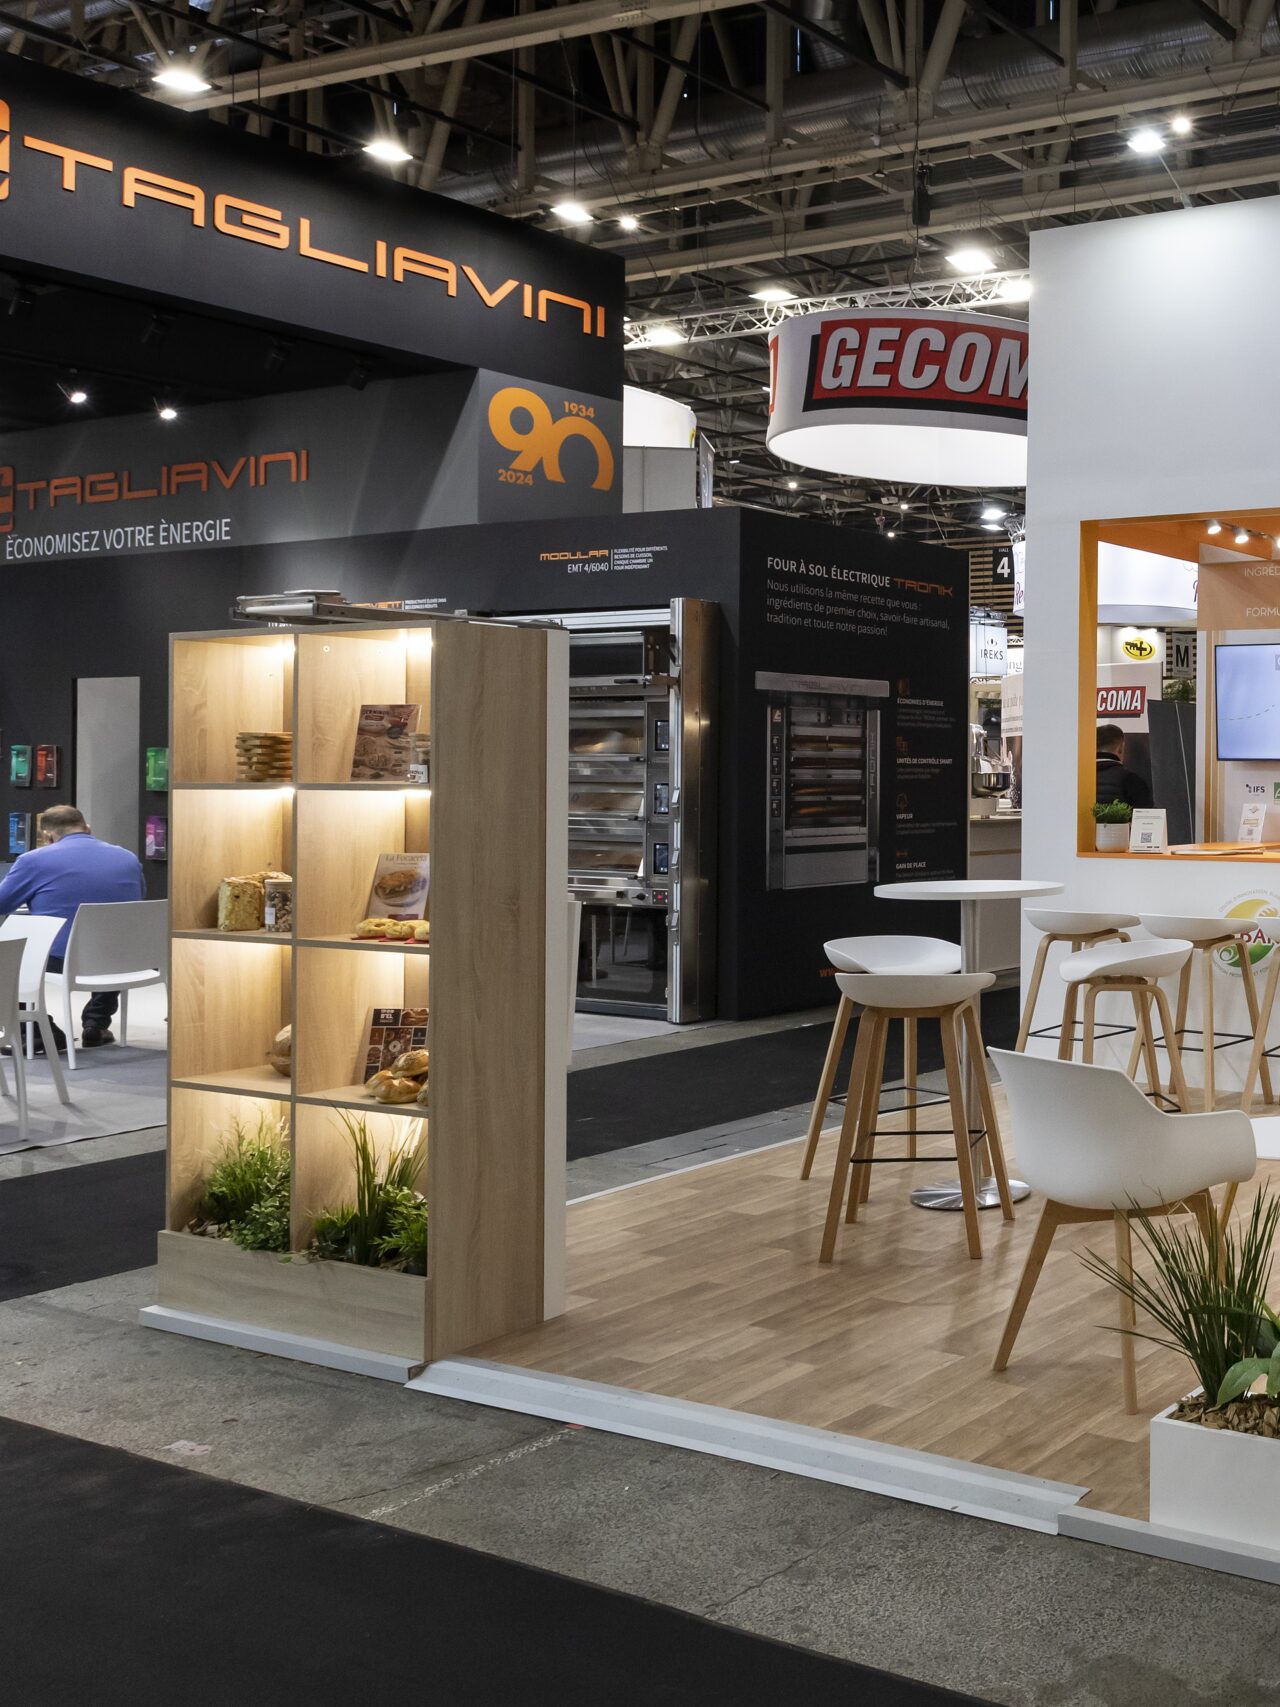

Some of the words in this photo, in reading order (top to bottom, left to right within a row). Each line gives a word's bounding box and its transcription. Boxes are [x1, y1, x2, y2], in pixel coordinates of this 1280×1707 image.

[24, 135, 605, 338] TAGLIAVINI
[820, 326, 1028, 399] GECOM
[563, 401, 595, 418] 1934
[16, 449, 309, 512] TAGLIAVINI
[498, 468, 534, 486] 2024
[103, 525, 155, 550] VOTRE
[540, 549, 609, 561] MODULAR
[996, 556, 1011, 578] 4
[567, 563, 583, 574] EMT
[583, 562, 609, 574] 4/6040
[767, 556, 796, 573] FOUR
[799, 558, 807, 574] À
[808, 563, 829, 578] SOL
[831, 564, 891, 588] ÉLECTRIQUE
[893, 577, 954, 597] TRONIK
[767, 578, 789, 592] Nous
[790, 581, 825, 598] utilisons
[826, 587, 833, 598] la
[834, 589, 859, 603] même
[860, 594, 885, 606] recette
[886, 598, 901, 609] que
[767, 596, 813, 613] ingrédients
[814, 601, 825, 613] de
[826, 605, 856, 618] premier
[857, 607, 879, 621] choix,
[879, 611, 918, 624] savoir-faire
[919, 617, 950, 631] artisanal,
[767, 612, 802, 626] tradition
[804, 617, 812, 628] et
[813, 617, 834, 630] toute
[836, 621, 856, 633] notre
[857, 625, 888, 637] passion!
[980, 648, 1004, 661] IREKS
[1175, 644, 1189, 668] M
[1097, 689, 1142, 711] COMA
[1253, 785, 1265, 793] IFS
